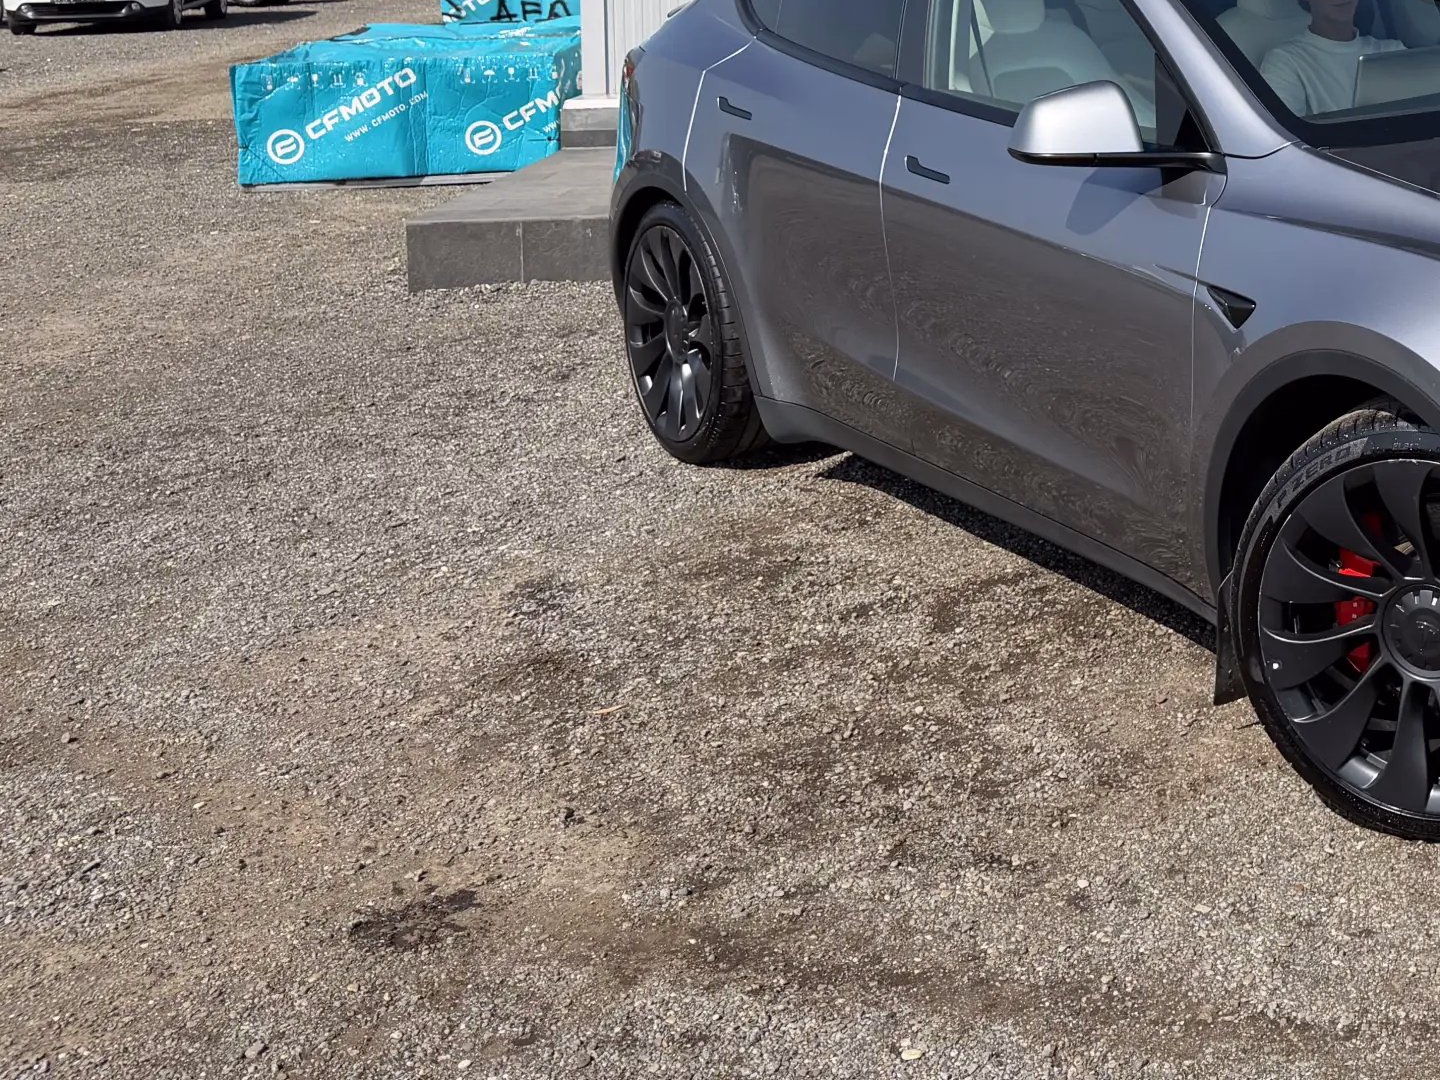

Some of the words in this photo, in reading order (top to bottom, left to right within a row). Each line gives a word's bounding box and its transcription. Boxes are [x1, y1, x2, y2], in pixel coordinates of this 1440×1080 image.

[305, 67, 417, 141] CFMOTO
[502, 85, 562, 131] CFM
[1290, 446, 1352, 492] ZERO
